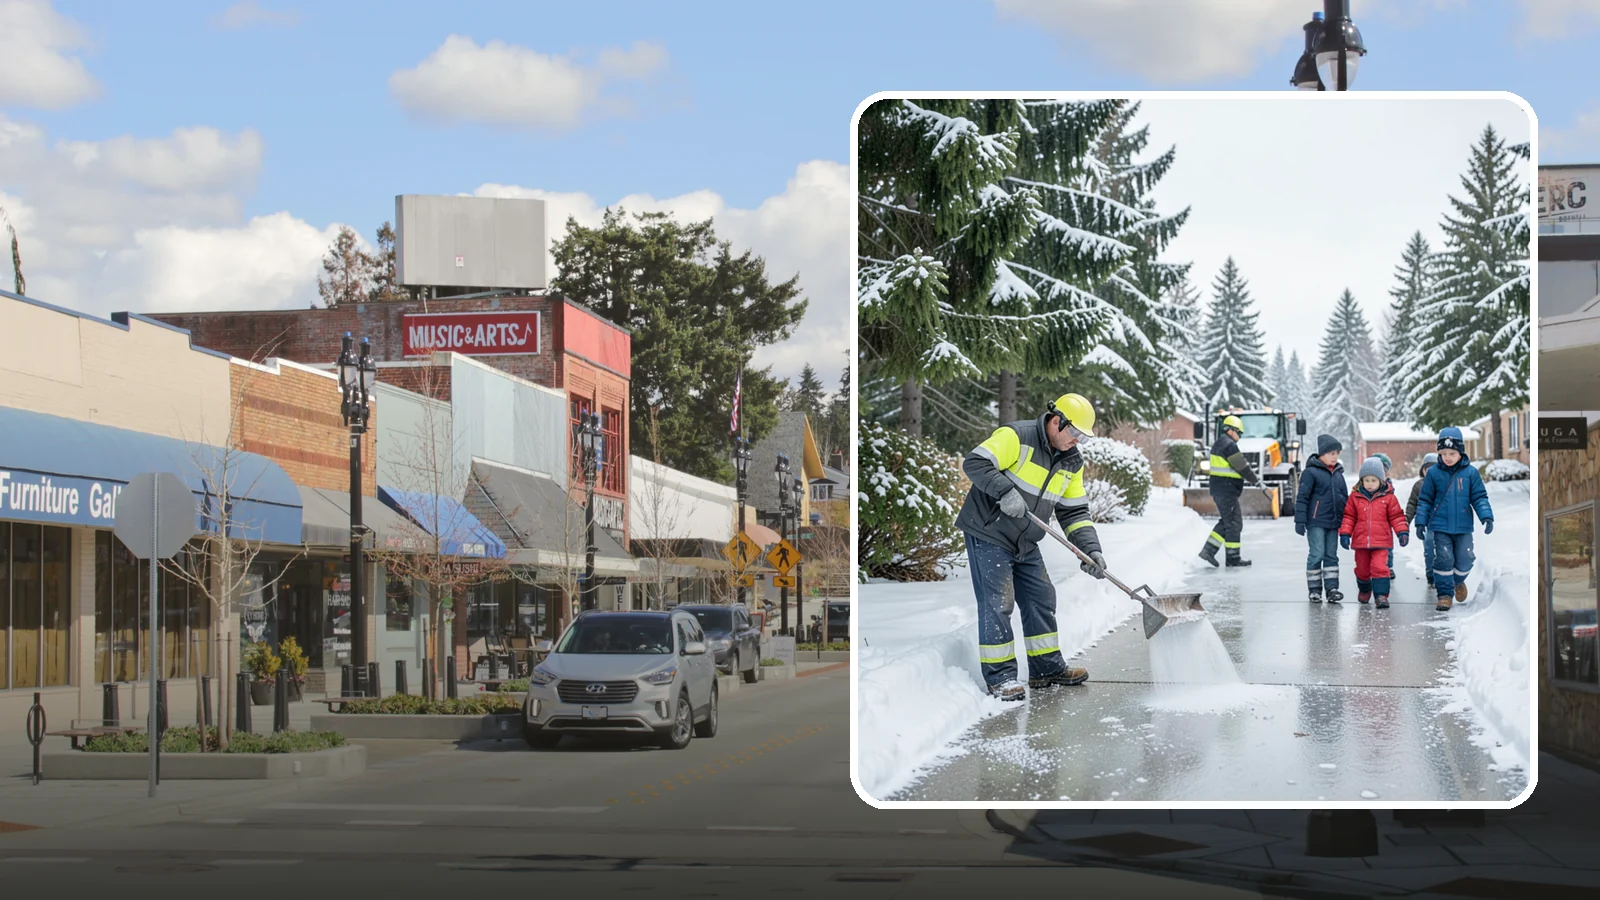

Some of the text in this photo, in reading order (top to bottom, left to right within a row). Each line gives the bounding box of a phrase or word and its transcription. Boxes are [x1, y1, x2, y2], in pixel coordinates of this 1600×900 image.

[0, 472, 121, 519] Furniture Gal
[454, 563, 478, 573] SUSHI
